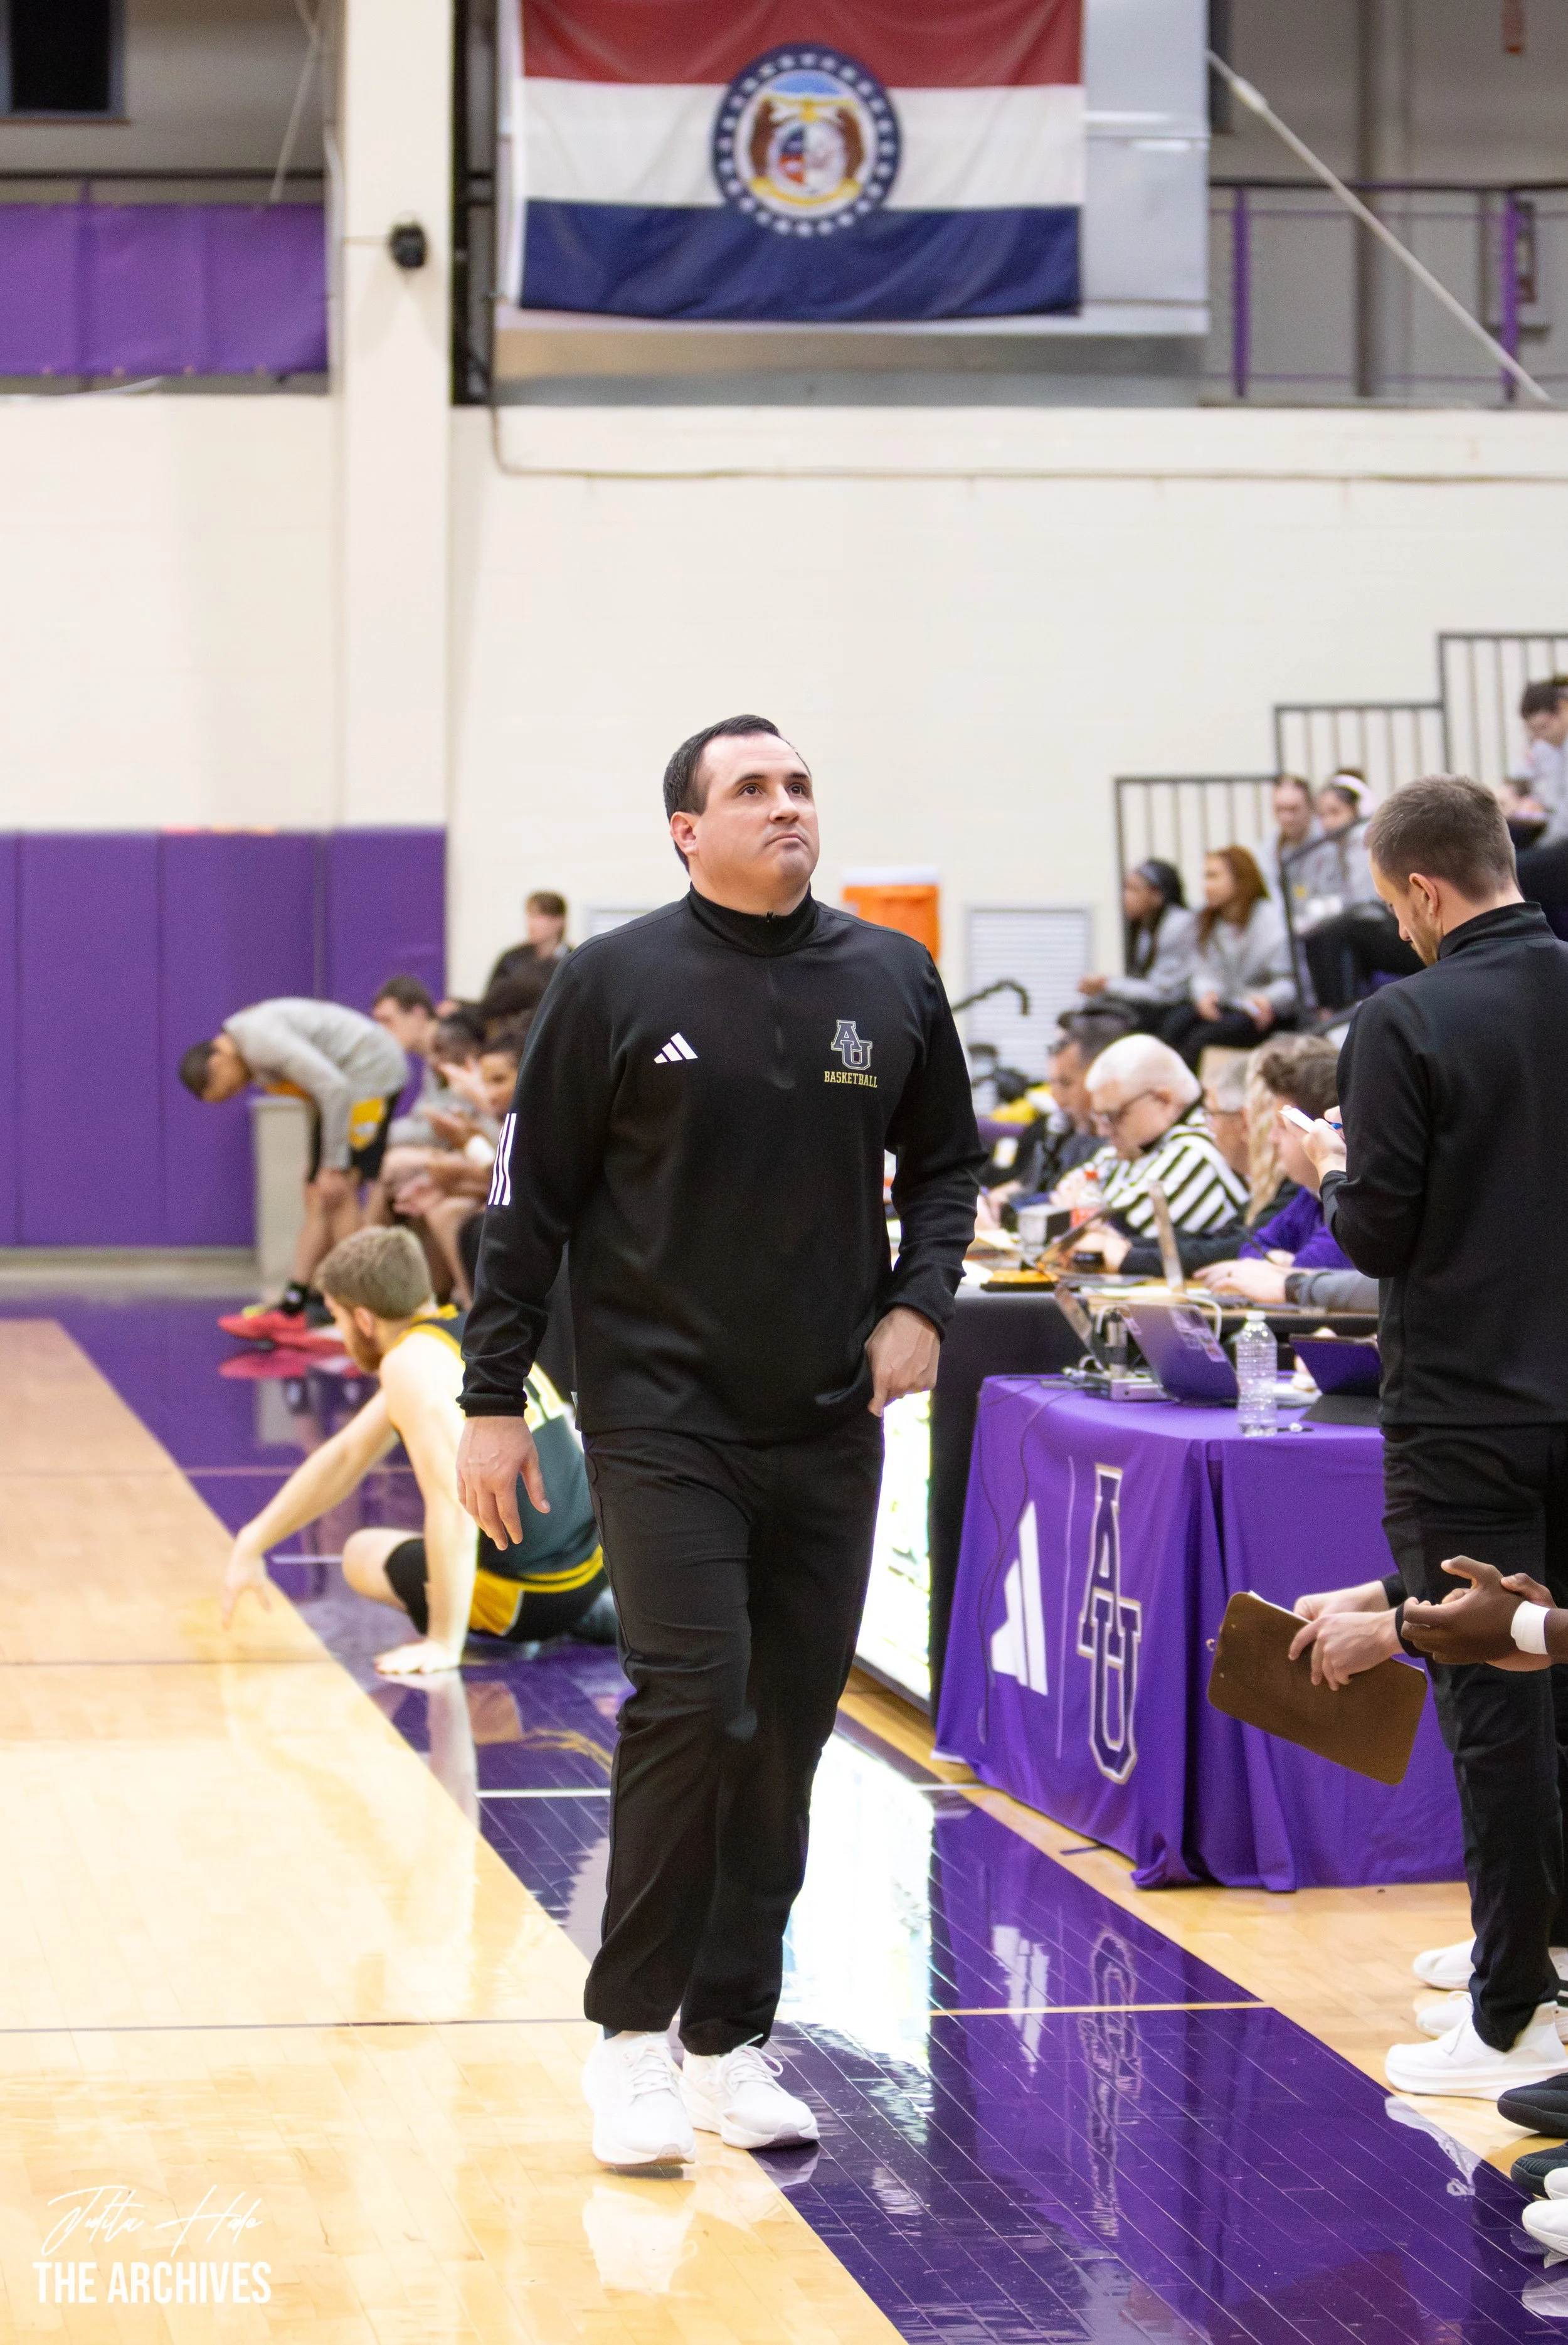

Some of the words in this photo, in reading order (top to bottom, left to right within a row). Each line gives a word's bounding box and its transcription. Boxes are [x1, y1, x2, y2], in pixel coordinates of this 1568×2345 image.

[830, 1019, 872, 1070] AU
[824, 1070, 877, 1088] BASKETBALL
[1076, 1462, 1142, 1784] AU
